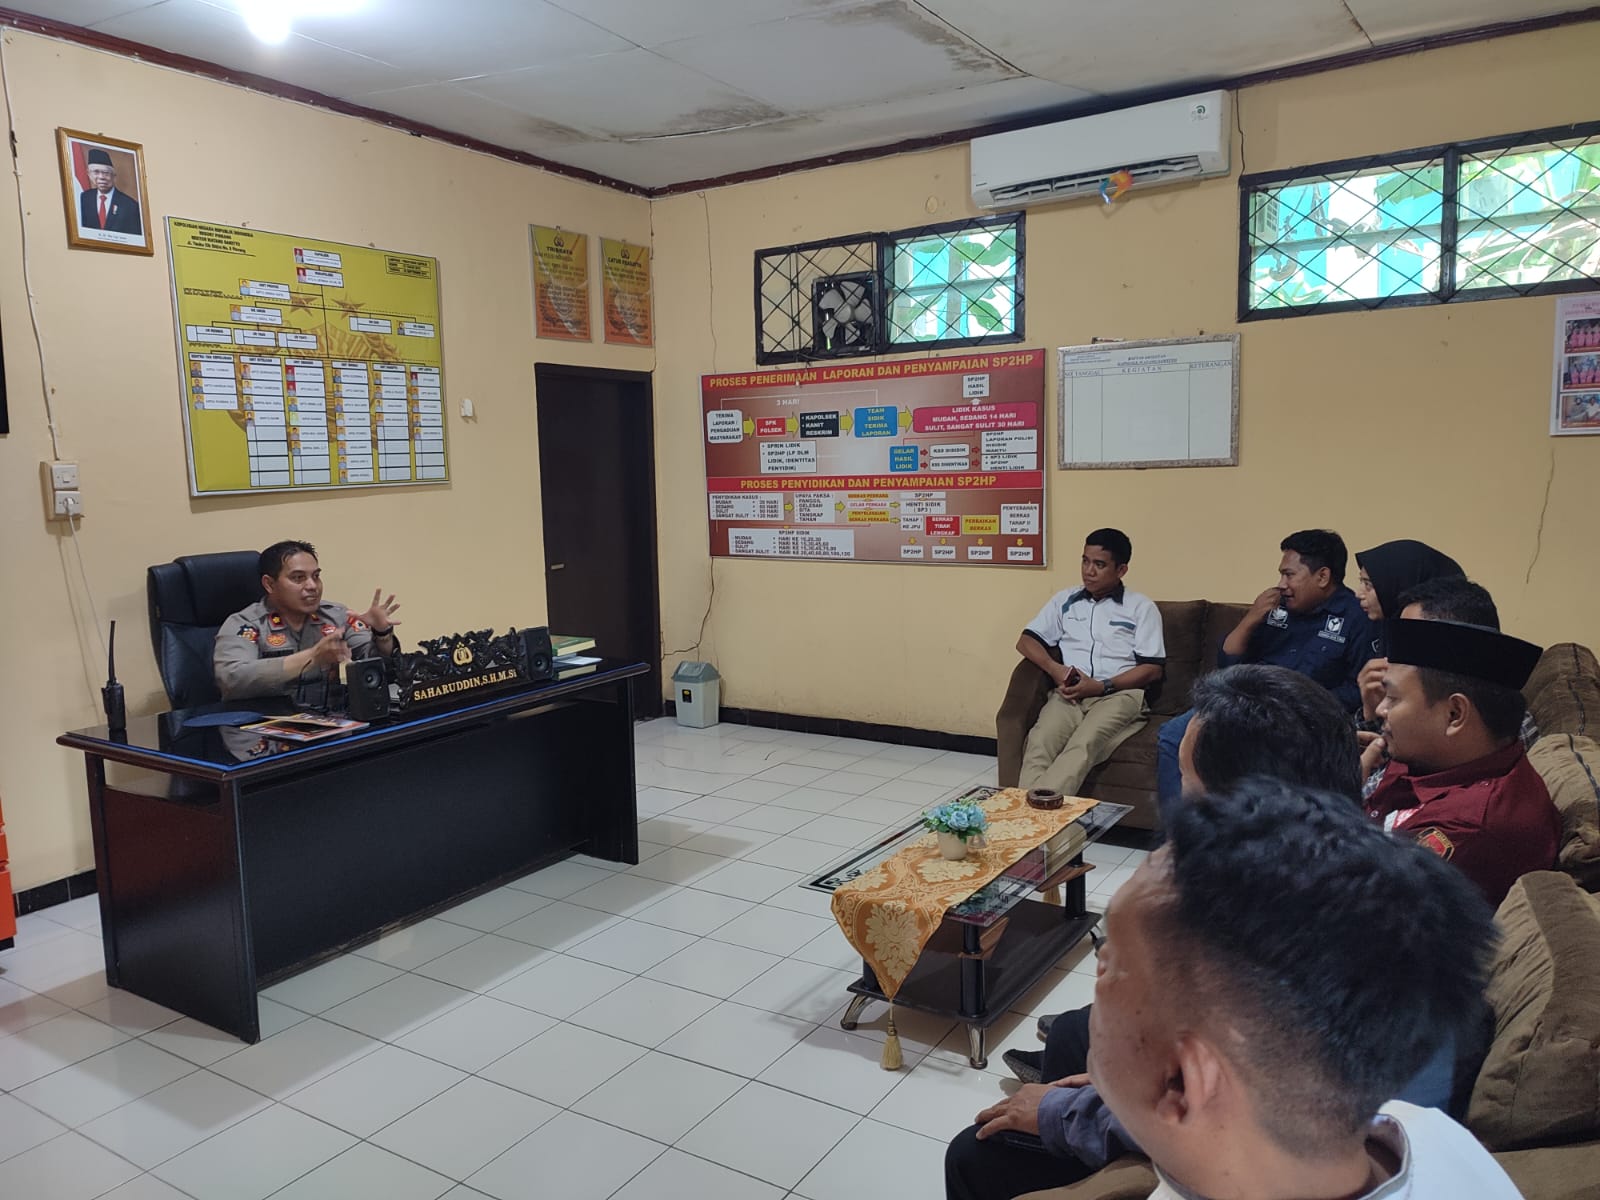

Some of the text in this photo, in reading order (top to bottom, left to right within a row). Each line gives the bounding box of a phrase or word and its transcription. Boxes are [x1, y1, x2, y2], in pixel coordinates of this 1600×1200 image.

[710, 354, 1034, 388] PROSES PENERIMAAN LAPORAN DAN PENYAMPAIAN SP2HP
[741, 476, 997, 489] PROSES PENYIDIKAN DAN PENYAMPAIAN SP2HP
